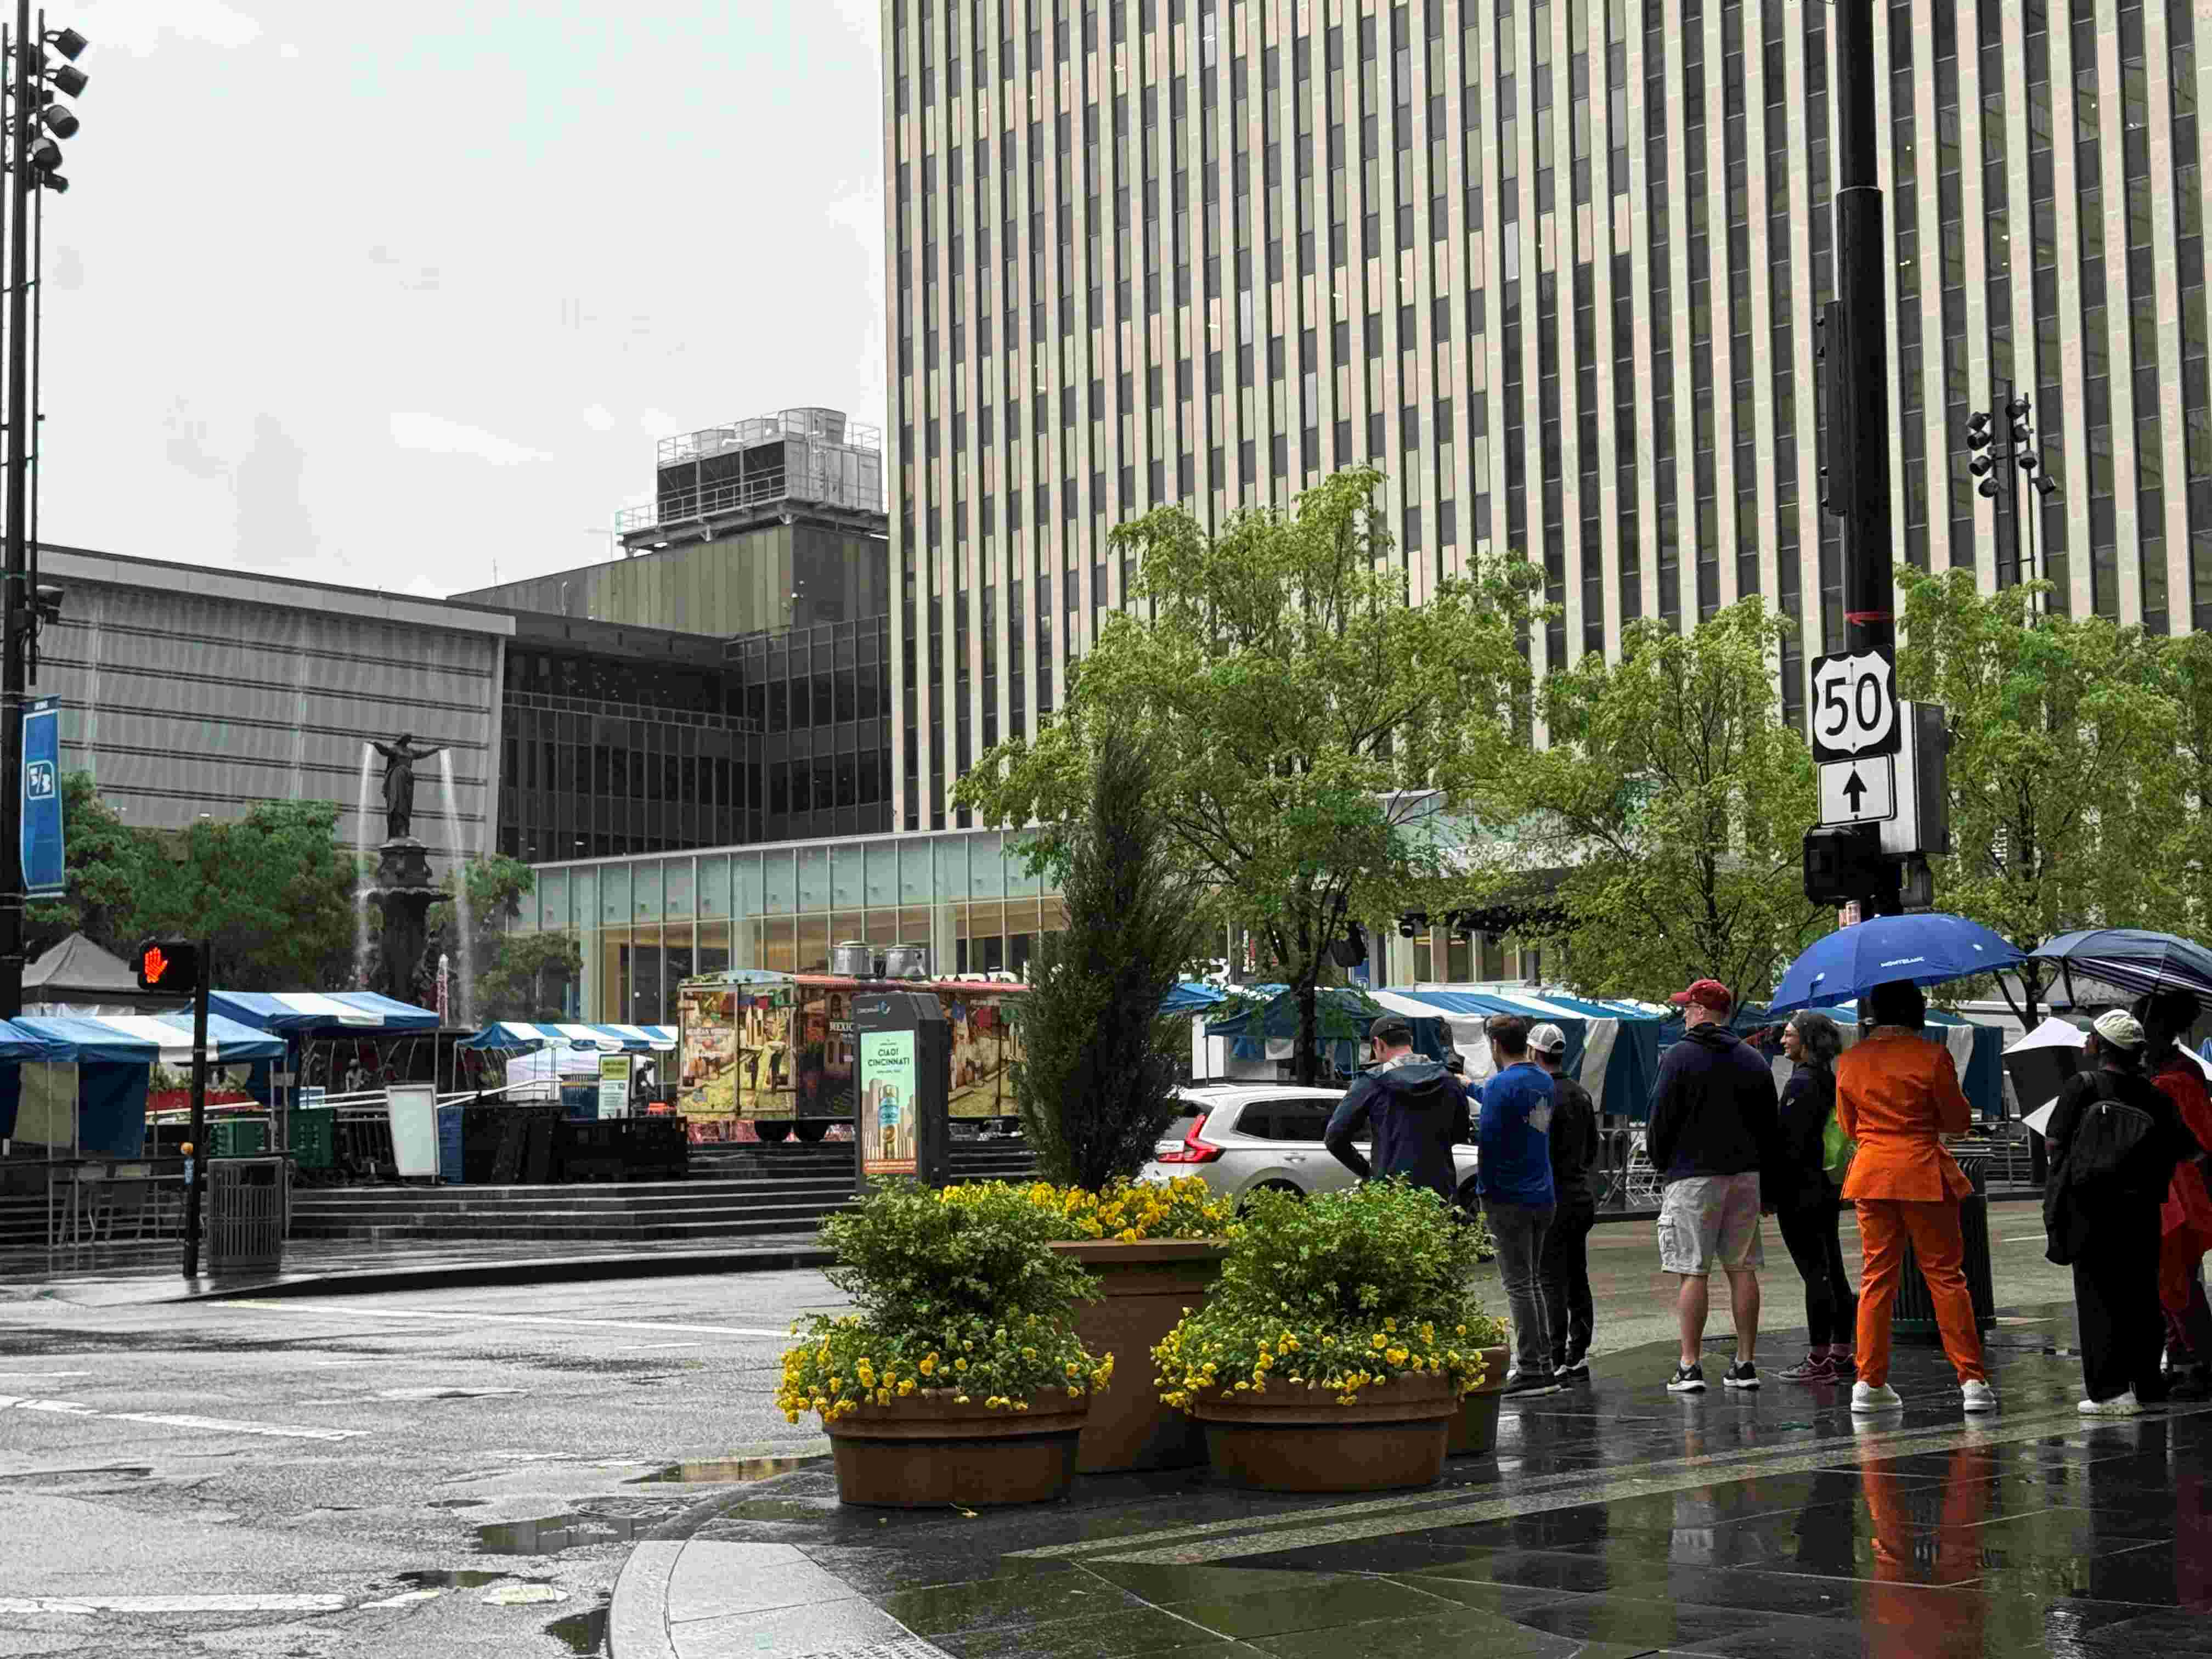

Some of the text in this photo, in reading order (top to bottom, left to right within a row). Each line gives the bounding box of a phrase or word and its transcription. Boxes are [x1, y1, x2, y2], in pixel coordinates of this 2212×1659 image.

[1825, 673, 1881, 736] 50
[878, 1048, 899, 1057] CIAO!
[867, 1057, 910, 1067] CINCINNATI
